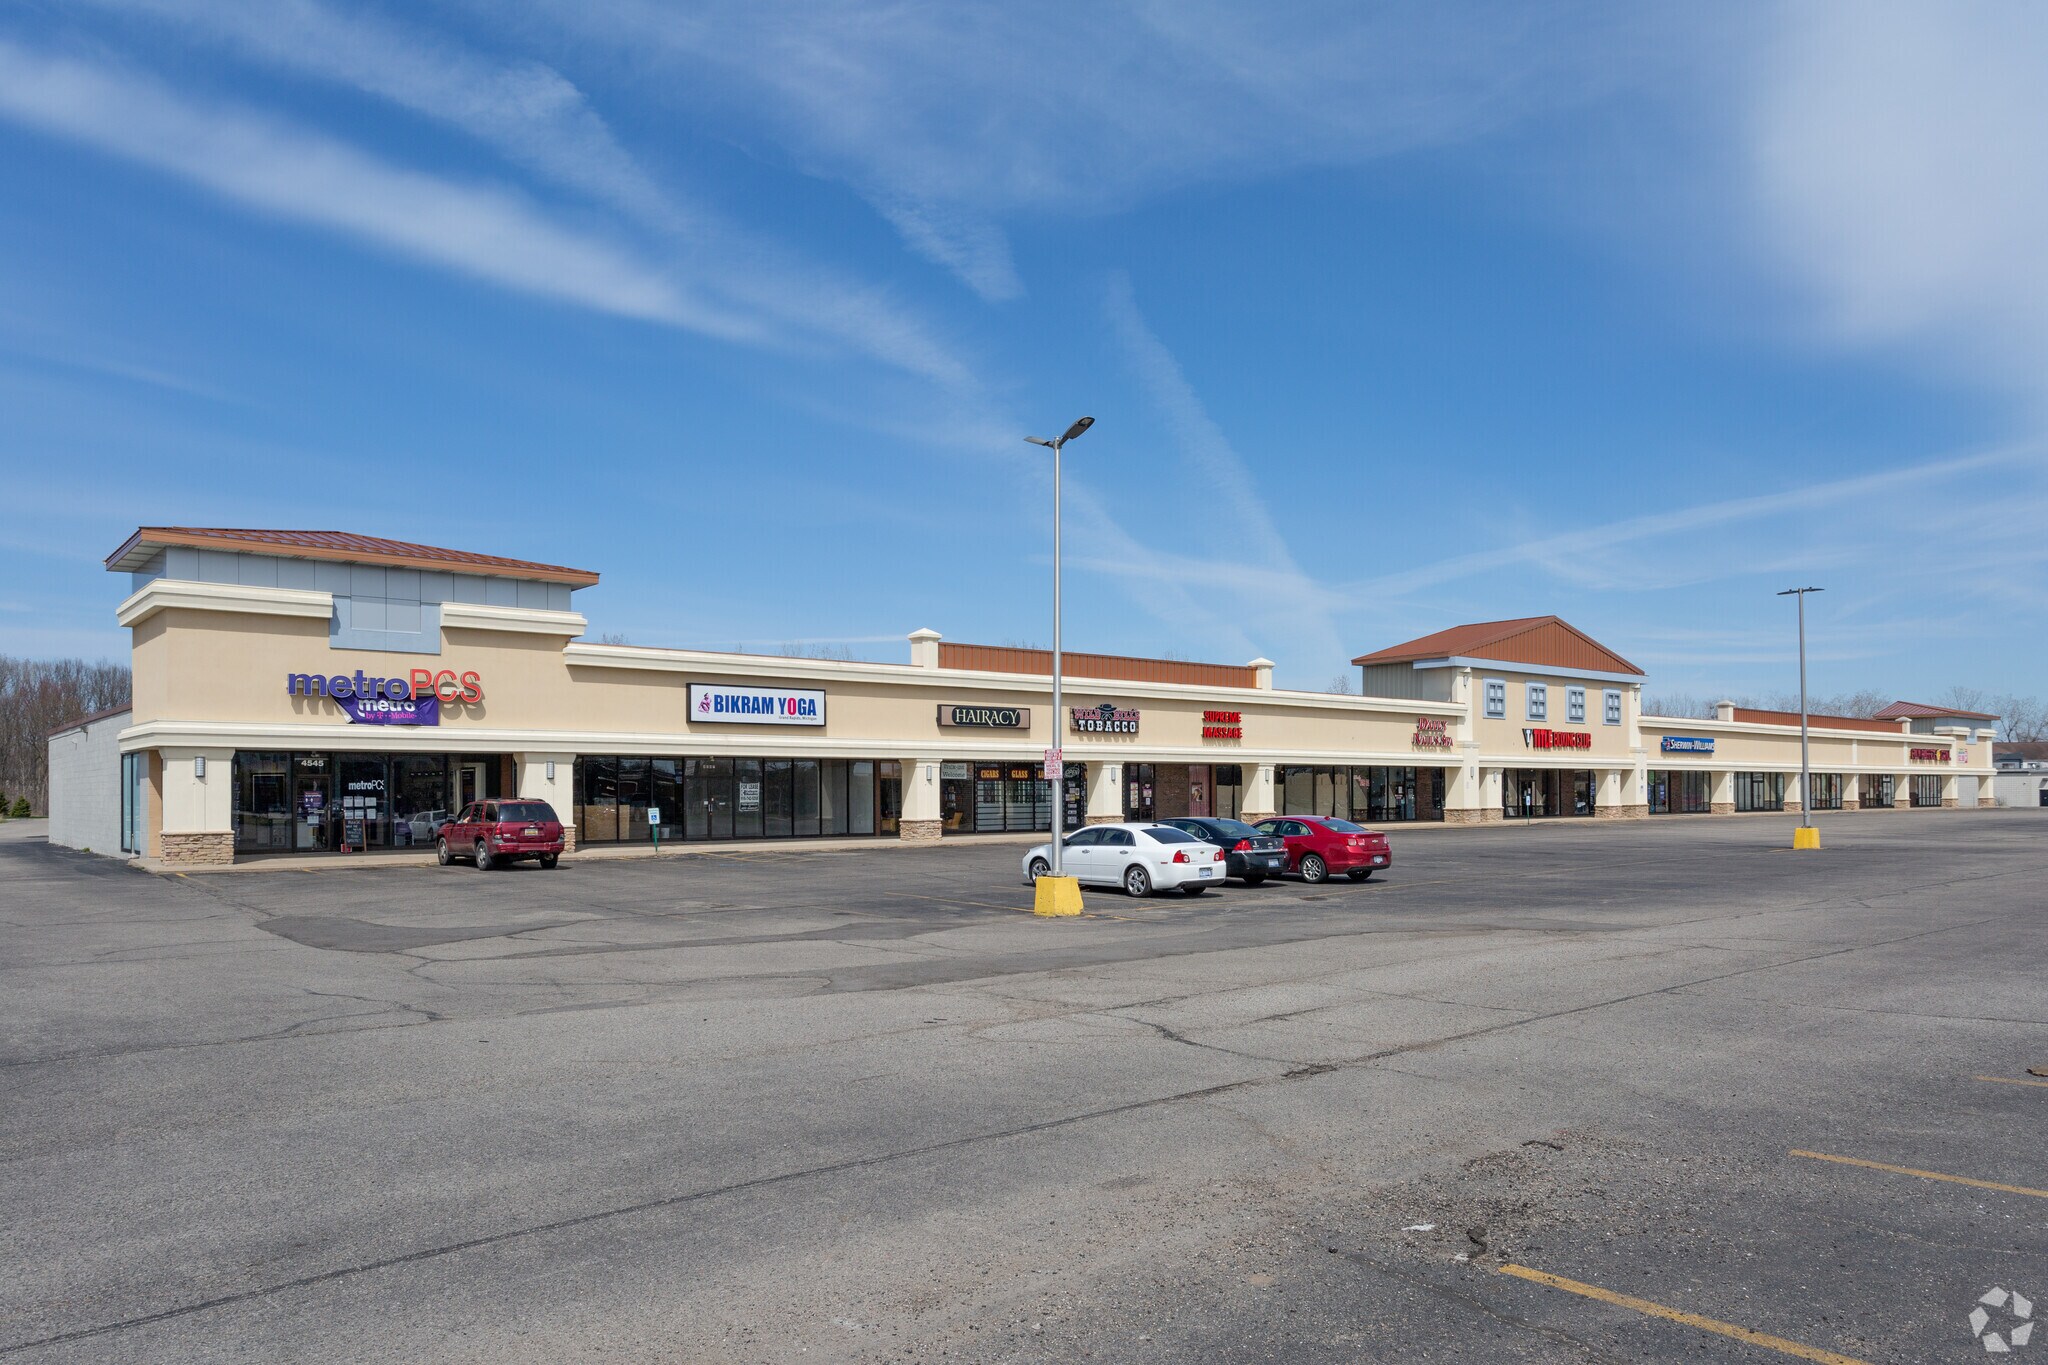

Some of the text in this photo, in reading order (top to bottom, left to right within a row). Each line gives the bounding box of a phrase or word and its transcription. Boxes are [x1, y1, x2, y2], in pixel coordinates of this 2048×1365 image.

[288, 668, 482, 703] metroPCS
[714, 694, 817, 716] BIKRAM YOGA
[955, 708, 1019, 727] HAIRACY
[1073, 708, 1101, 720] WILD
[1203, 711, 1242, 723] SUPREME
[1078, 720, 1136, 733] TOBACCO
[1202, 727, 1243, 739] MASSAGE
[1533, 729, 1553, 748] TITLE
[1552, 732, 1576, 748] BOXING
[1575, 733, 1592, 749] CLUB
[1670, 739, 1715, 750] SHERWIN-WILLIAMS
[980, 769, 1000, 779] CIGARS
[1011, 770, 1029, 779] GLASS
